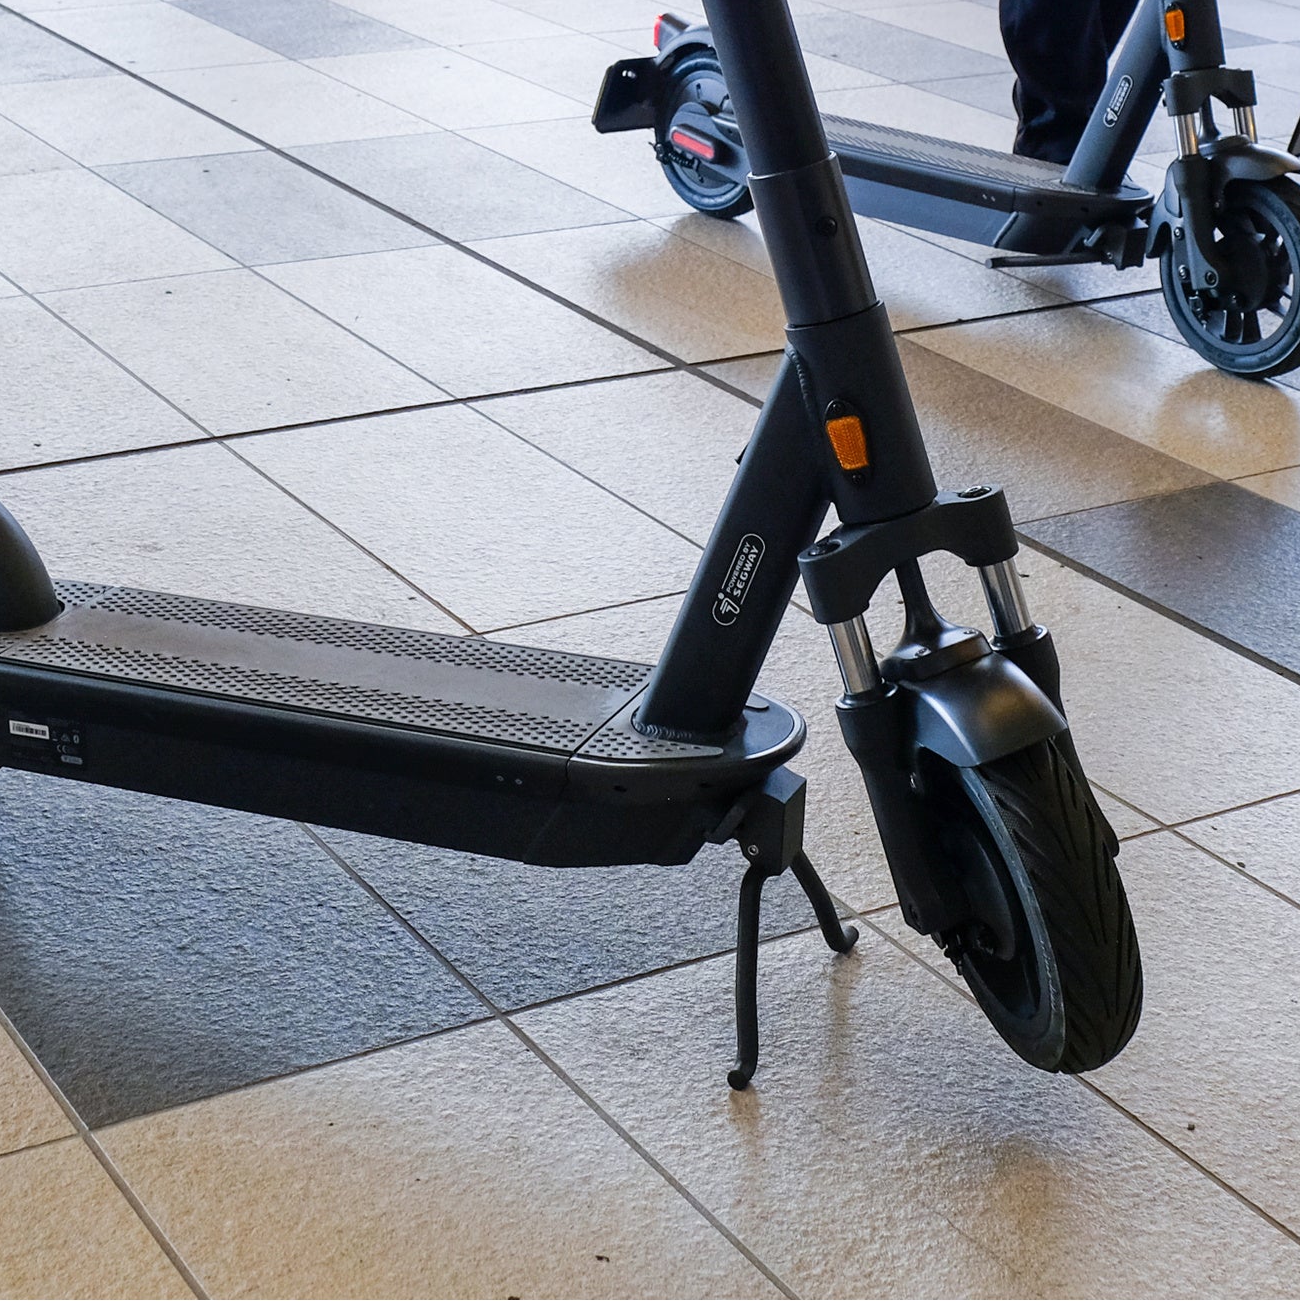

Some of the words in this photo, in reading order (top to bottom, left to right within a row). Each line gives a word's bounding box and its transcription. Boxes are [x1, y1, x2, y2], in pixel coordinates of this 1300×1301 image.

[726, 553, 746, 594] POWERED
[742, 541, 751, 554] BY
[733, 545, 759, 598] SEGWAY
